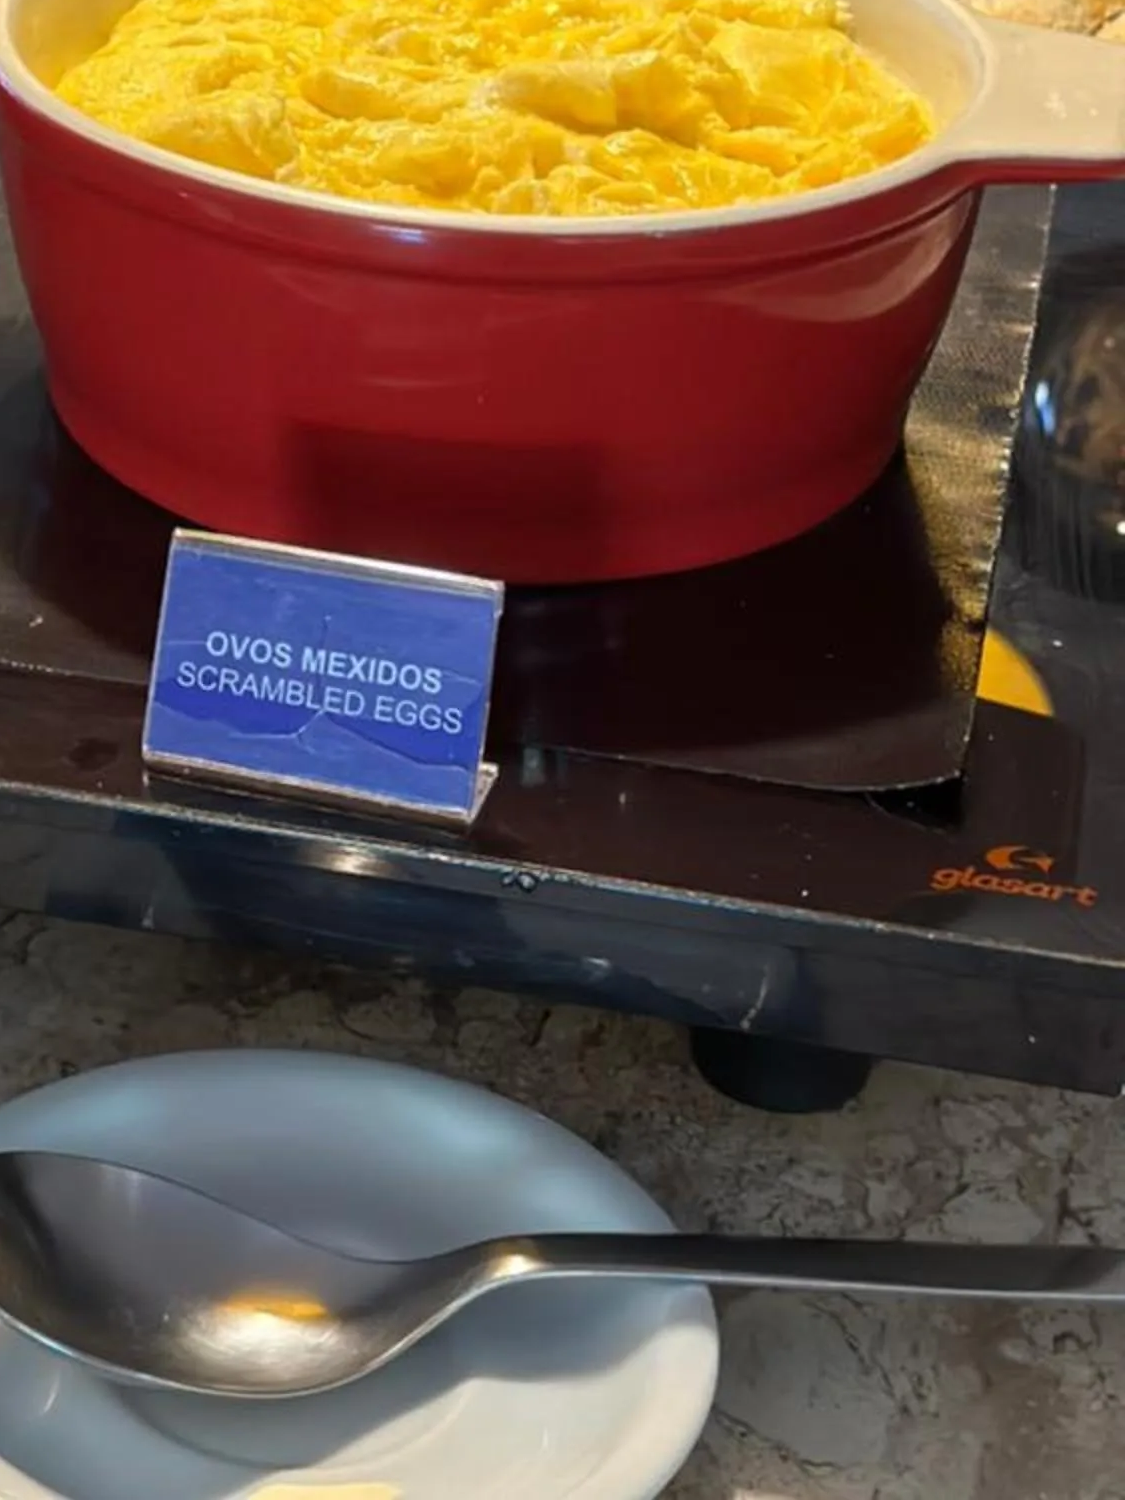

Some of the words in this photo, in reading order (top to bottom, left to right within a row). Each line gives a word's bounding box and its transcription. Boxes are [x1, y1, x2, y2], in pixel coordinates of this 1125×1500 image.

[206, 631, 292, 668] OVOS
[301, 648, 442, 694] MEXIDOS
[177, 661, 366, 717] SCRAMBLED
[374, 695, 463, 735] EGGS
[930, 866, 1098, 907] glasart
